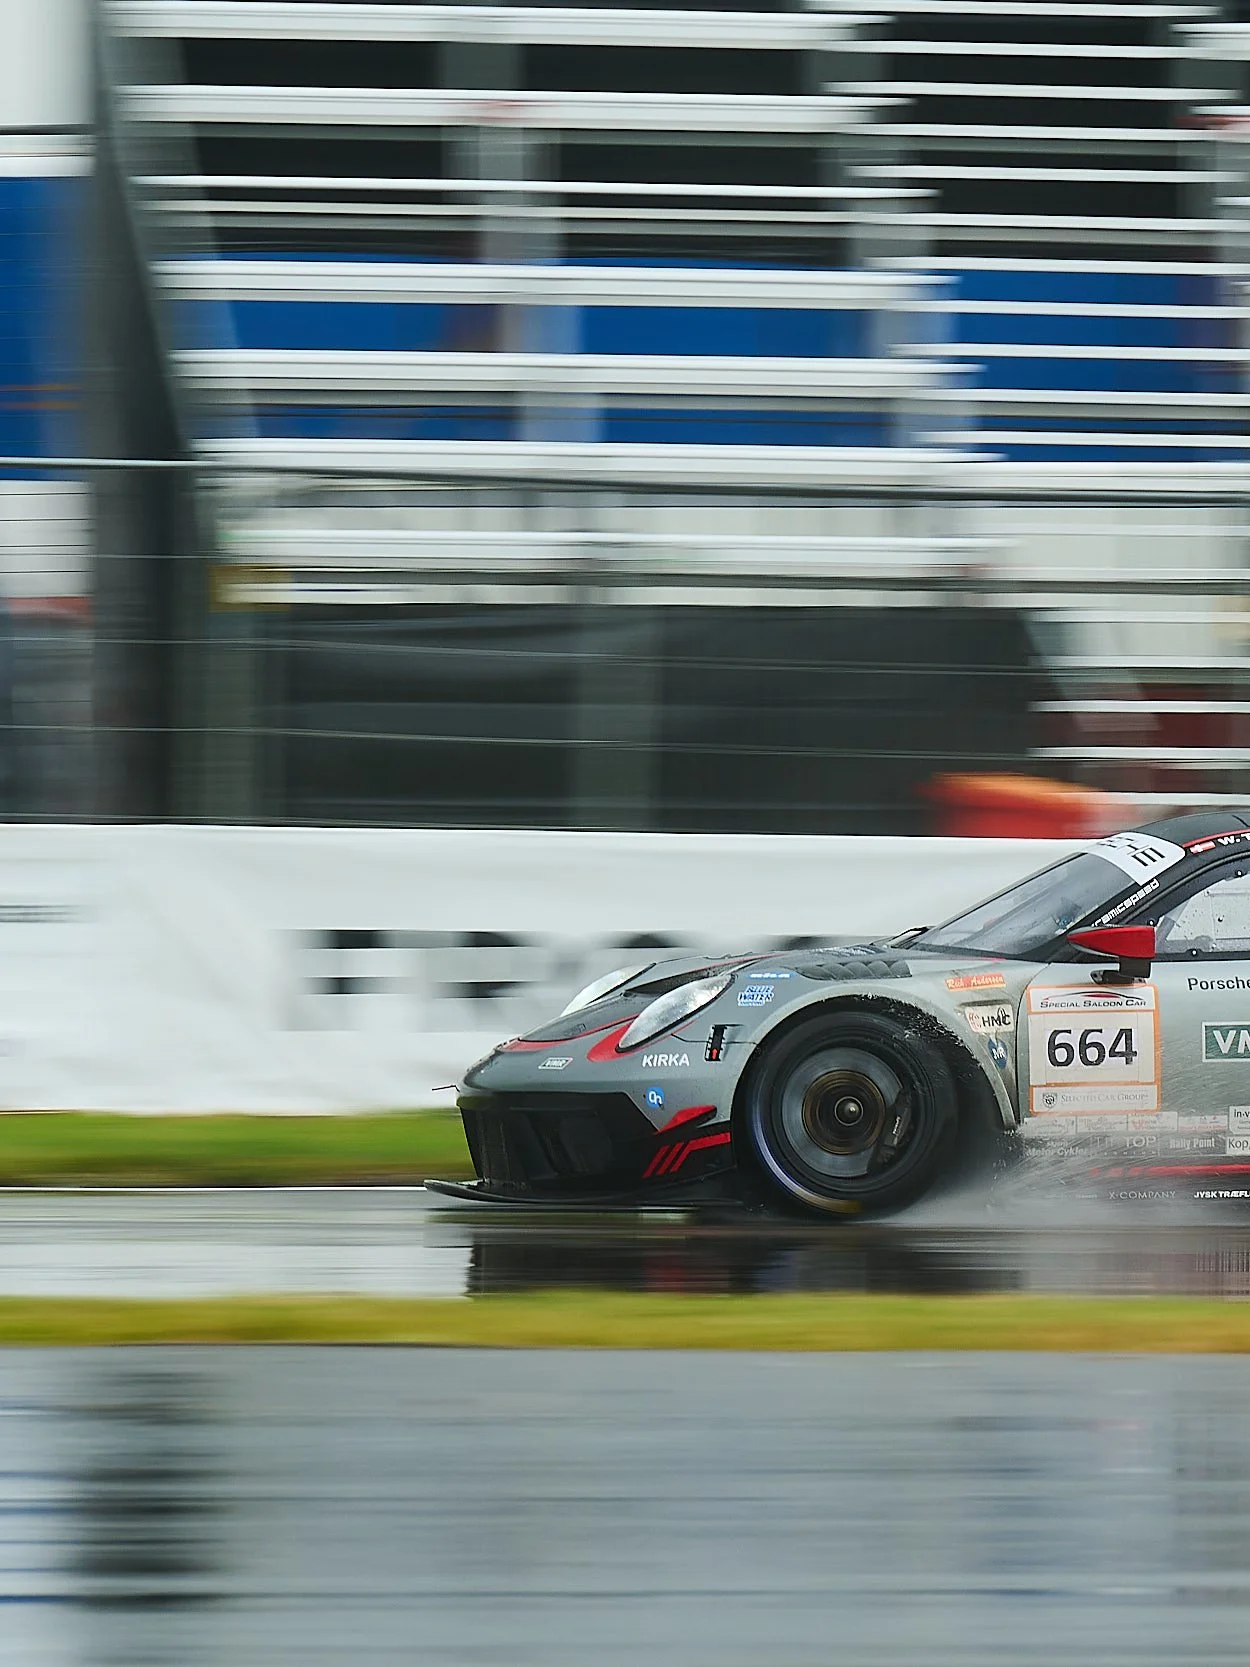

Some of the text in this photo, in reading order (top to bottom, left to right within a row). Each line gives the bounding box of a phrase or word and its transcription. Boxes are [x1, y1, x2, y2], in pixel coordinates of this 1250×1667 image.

[1040, 1000, 1081, 1008] SPECIAL
[1083, 999, 1123, 1008] SALOON
[1047, 1028, 1138, 1067] 664
[642, 1053, 690, 1068] KIRKA
[1123, 1136, 1157, 1148] TOP
[1193, 1190, 1218, 1199] JYSK
